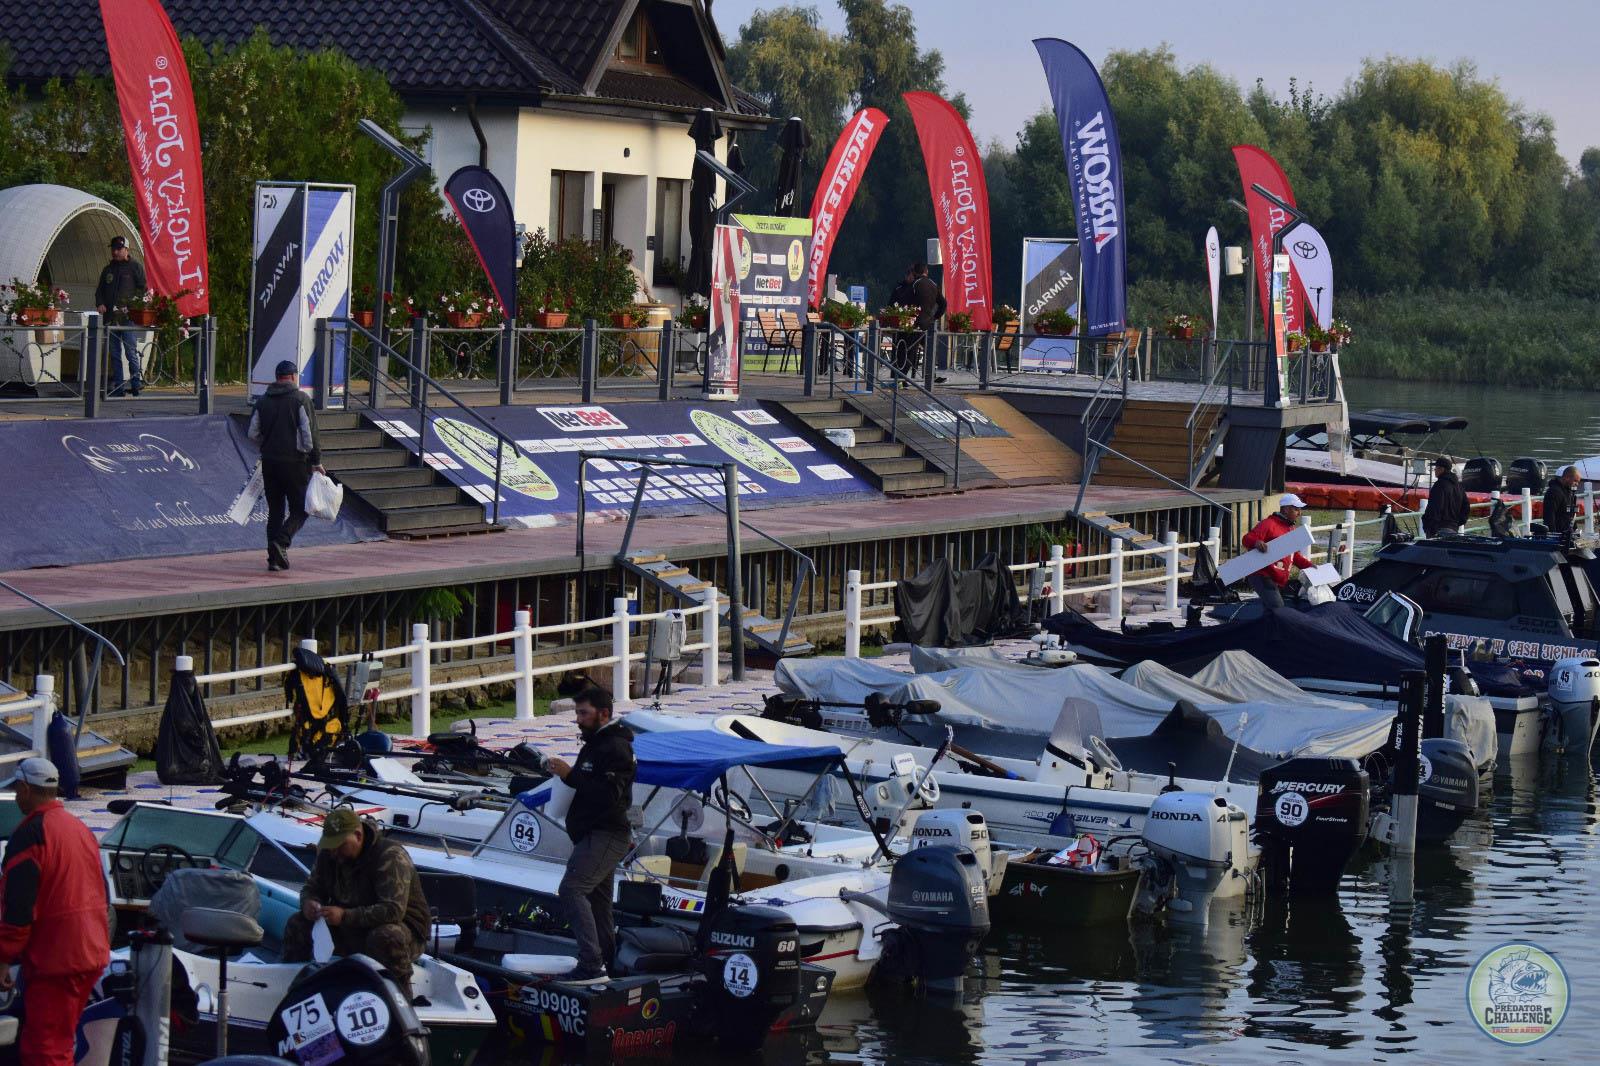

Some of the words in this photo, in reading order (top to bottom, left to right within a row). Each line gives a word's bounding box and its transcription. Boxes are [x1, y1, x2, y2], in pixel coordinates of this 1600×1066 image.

[260, 242, 298, 308] DAIWA
[305, 231, 345, 318] ARROW
[756, 277, 782, 290] NetBet
[1028, 272, 1074, 316] GARMIN
[542, 409, 622, 428] NetBet
[1508, 640, 1540, 659] CASA
[1560, 670, 1570, 683] 45
[1394, 722, 1403, 750] TALON
[1270, 780, 1346, 794] MERCURY
[1440, 776, 1468, 787] YAMAHA
[1151, 811, 1203, 821] HONDA
[1281, 802, 1303, 817] 90
[514, 823, 535, 842] 84
[912, 827, 952, 837] HONDA
[970, 829, 989, 840] 50
[920, 890, 954, 903] YAMAHA
[710, 930, 755, 948] SUZUKI
[777, 940, 796, 953] 60
[729, 967, 750, 986] 14
[289, 1000, 321, 1031] 75
[347, 1006, 378, 1032] 10
[557, 1013, 586, 1037] MC
